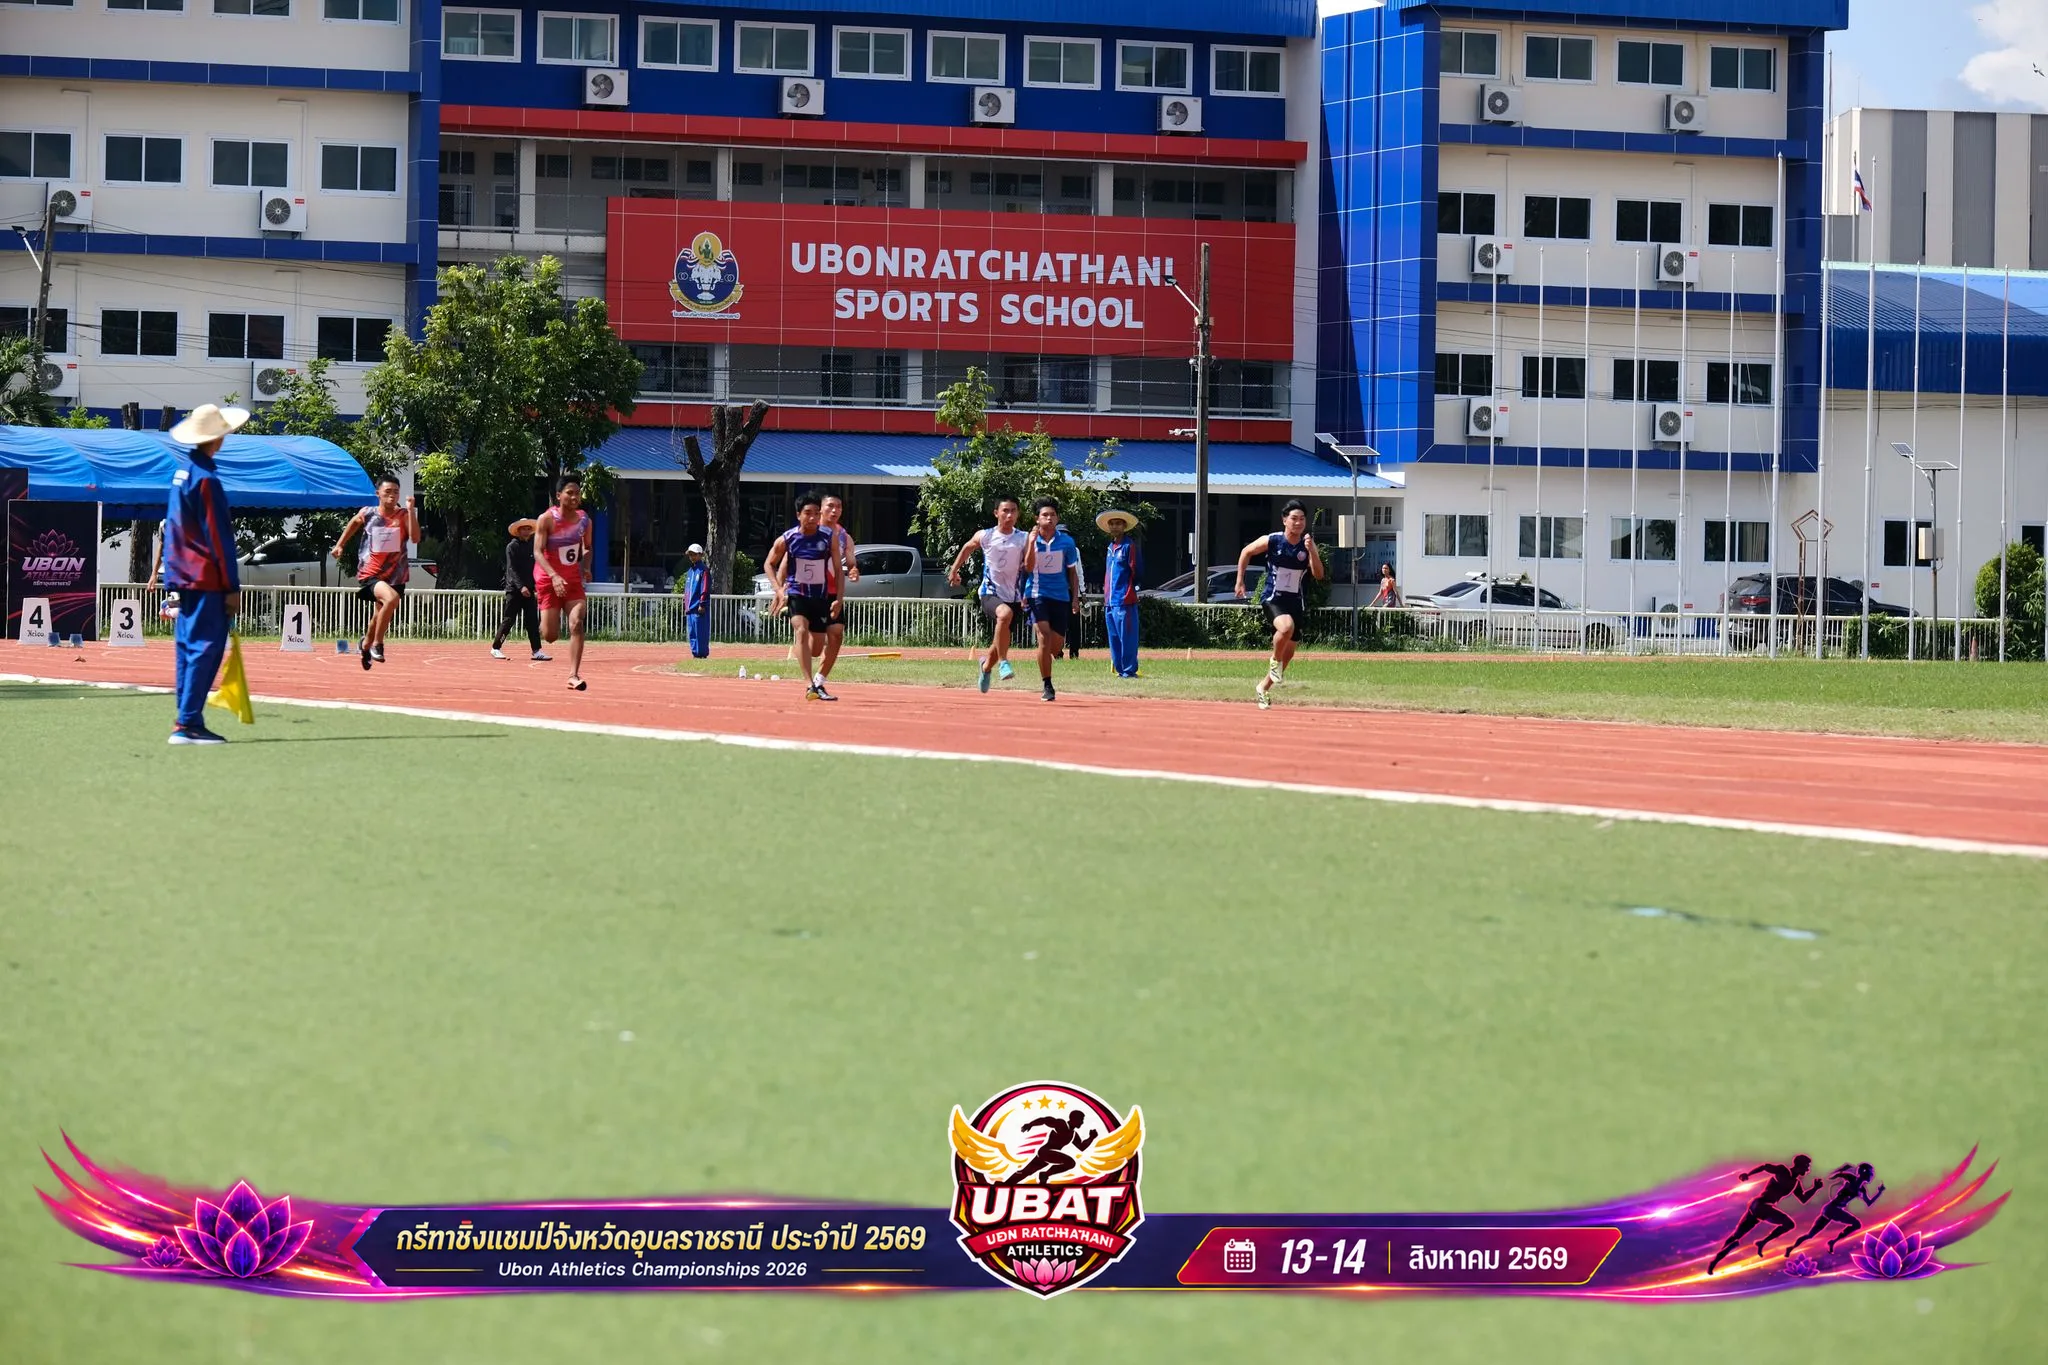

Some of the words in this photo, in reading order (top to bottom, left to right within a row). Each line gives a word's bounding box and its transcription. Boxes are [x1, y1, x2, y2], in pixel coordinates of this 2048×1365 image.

[791, 242, 1174, 287] UBONRATCHATHANI
[835, 288, 978, 323] SPORTS
[1000, 294, 1144, 329] SCHOOL
[21, 556, 86, 571] UBON
[566, 549, 576, 562] 6
[1044, 555, 1054, 568] 2
[24, 571, 82, 580] ATHLETICS
[804, 563, 816, 581] 5
[29, 605, 43, 629] 4
[119, 607, 134, 630] 3
[292, 611, 302, 635] 1
